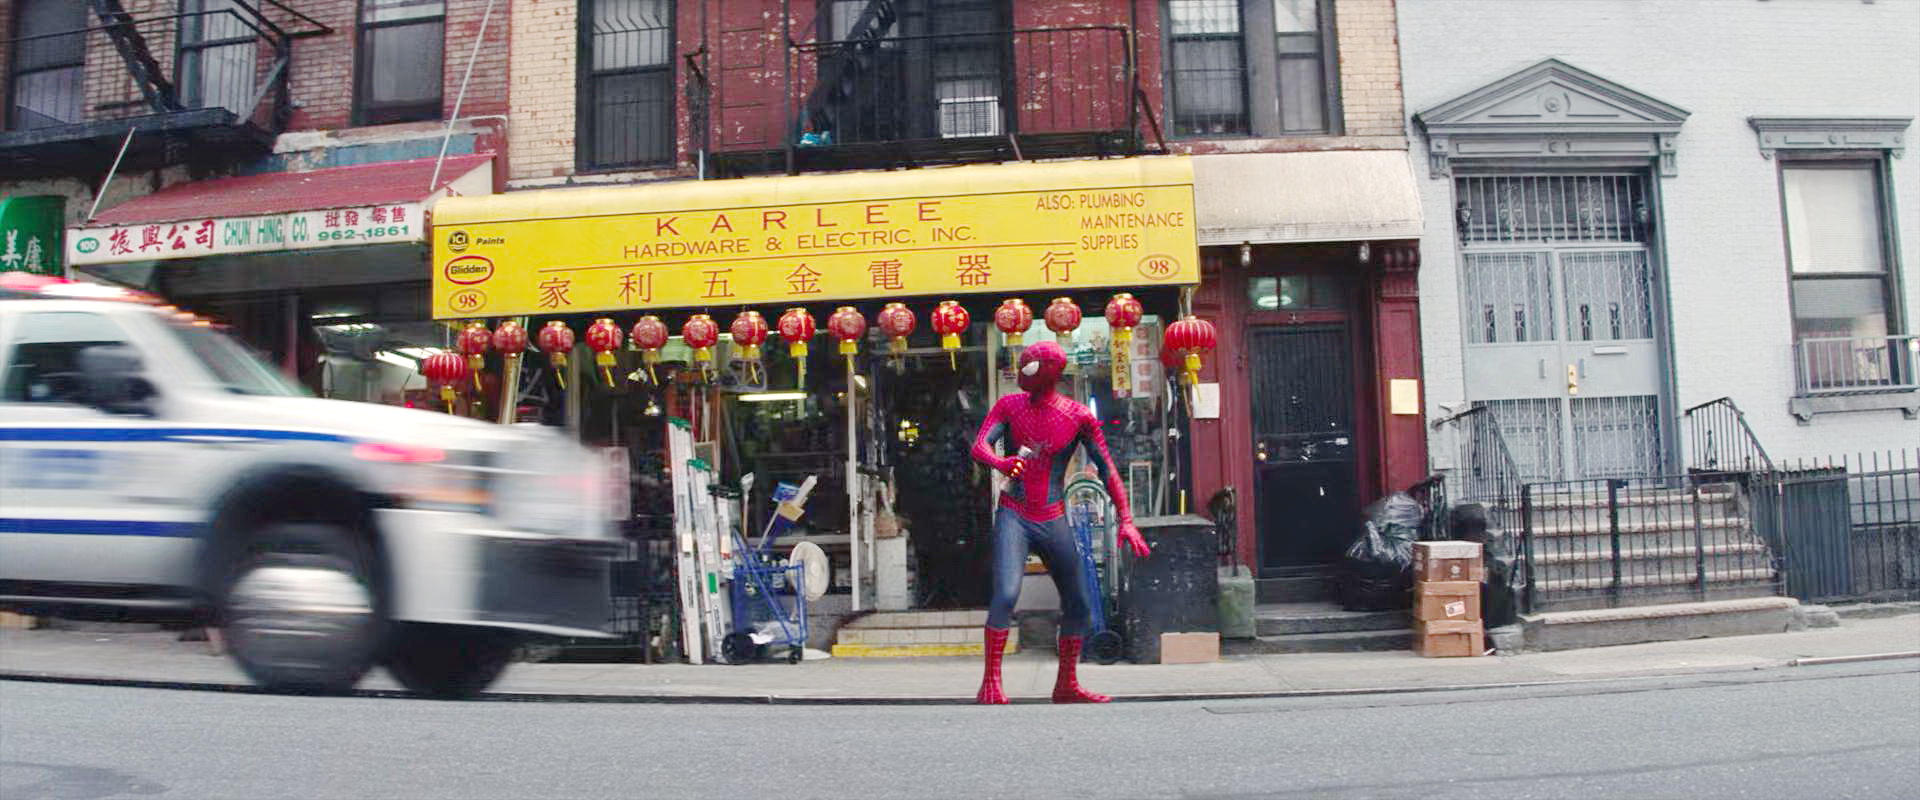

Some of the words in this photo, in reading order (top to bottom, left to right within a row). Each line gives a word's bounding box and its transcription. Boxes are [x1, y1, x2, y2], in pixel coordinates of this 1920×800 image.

[1036, 194, 1075, 211] ALSO:
[1079, 192, 1145, 209] PLUMBING
[656, 201, 943, 237] KARLEE
[1081, 212, 1184, 230] MAINTENANCE
[223, 220, 250, 246] CHUN
[318, 225, 410, 241] 962-1861
[476, 236, 505, 246] Paints
[1081, 233, 1139, 251] SUPPLIES
[79, 239, 97, 252] 100
[623, 238, 750, 260] HARDWARE
[766, 236, 782, 251] &
[932, 226, 977, 243] INC.
[450, 265, 488, 275] Glidden
[1150, 259, 1169, 275] 98
[538, 251, 1077, 309] 家利五金電器行
[459, 293, 478, 308] 98
